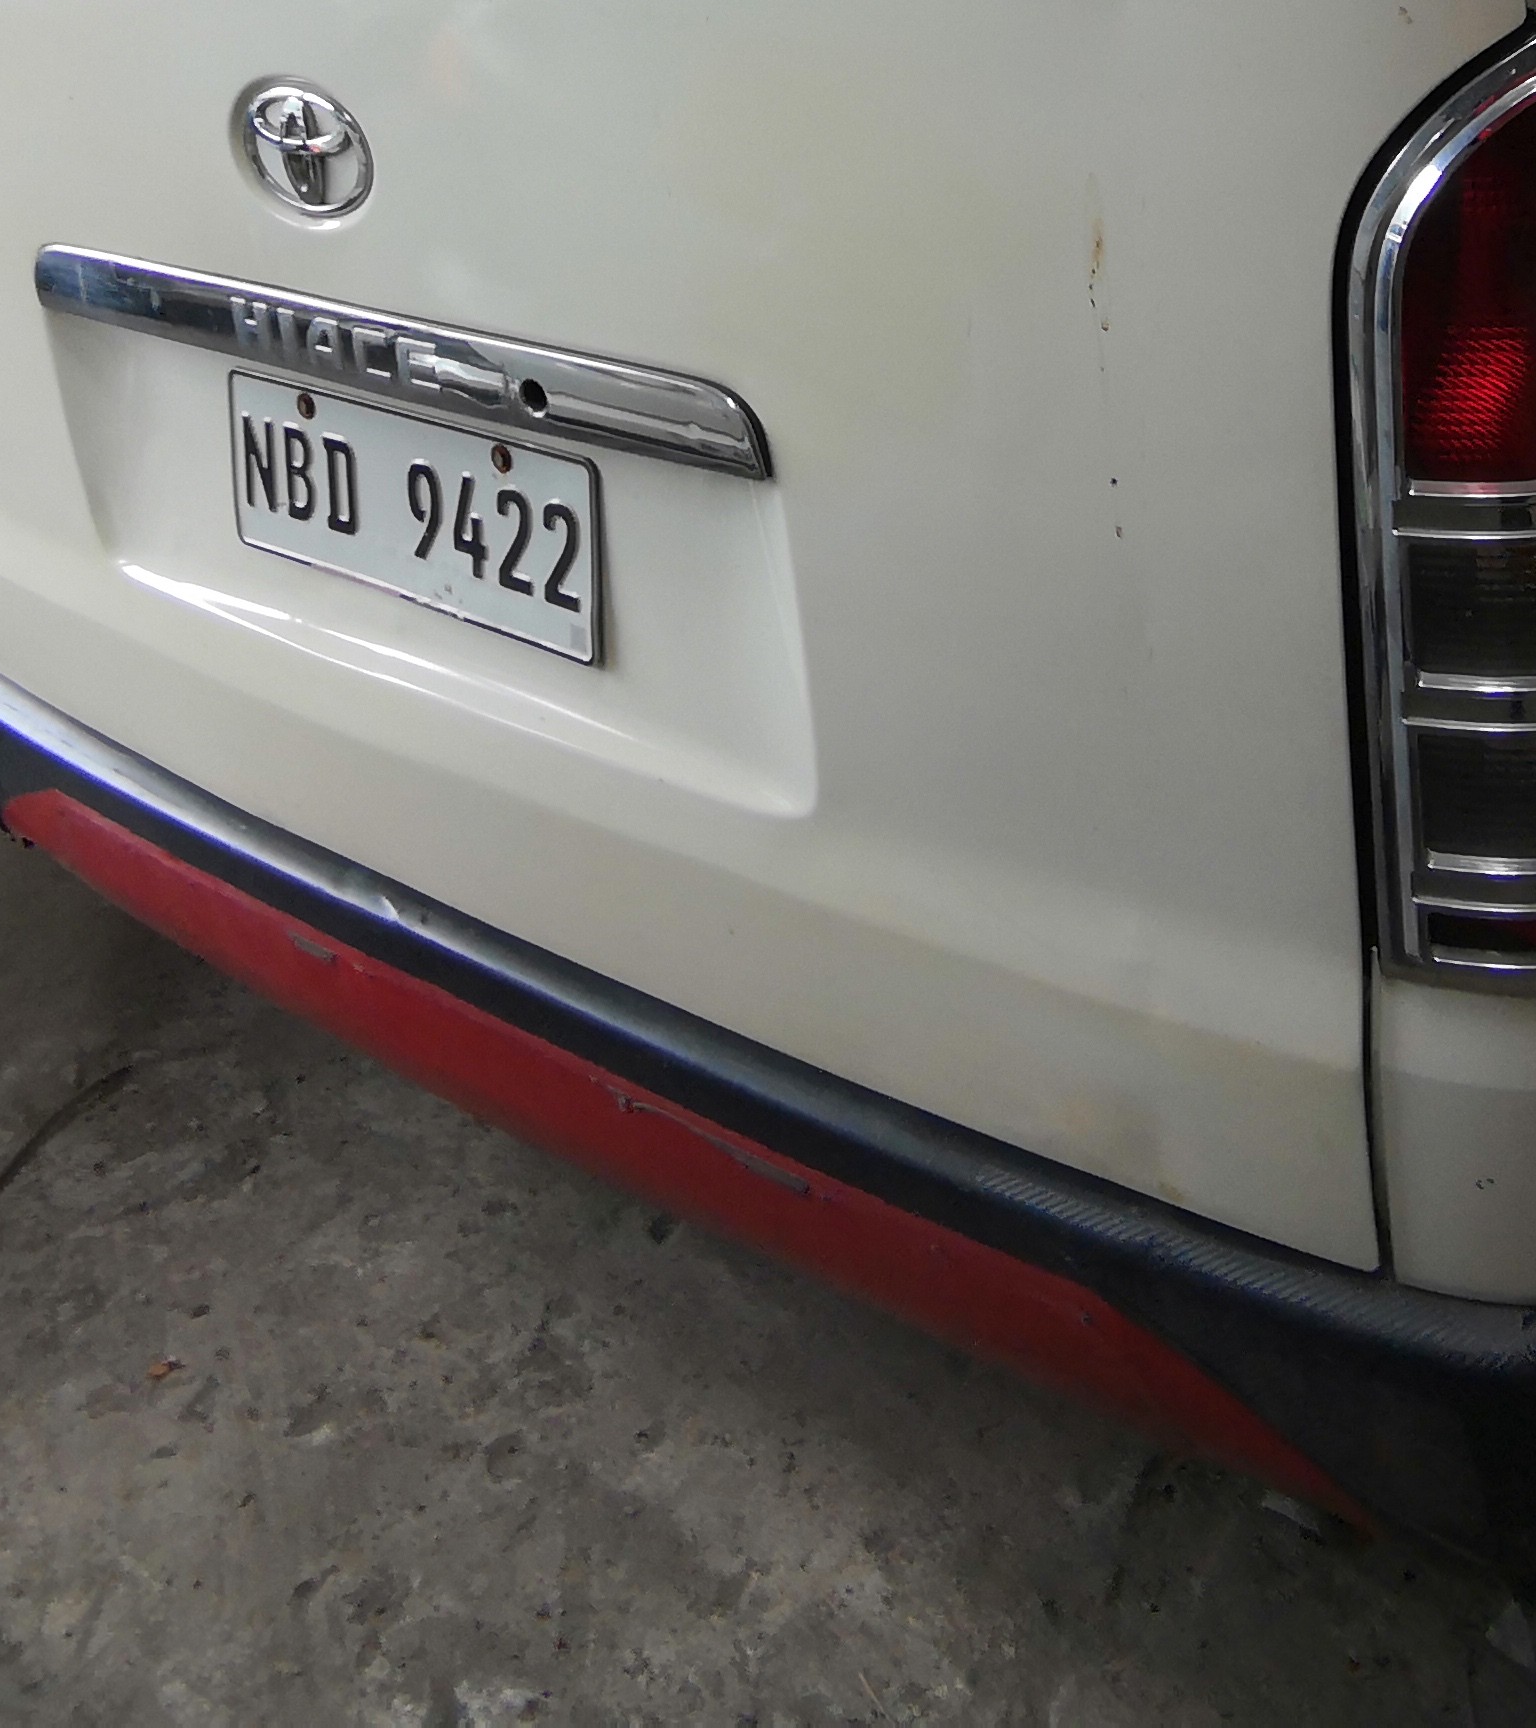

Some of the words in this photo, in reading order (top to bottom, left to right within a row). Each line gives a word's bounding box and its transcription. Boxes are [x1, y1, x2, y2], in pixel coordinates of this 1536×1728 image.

[229, 296, 443, 391] HIACE
[241, 410, 360, 536] NBD
[407, 457, 582, 614] 9422
